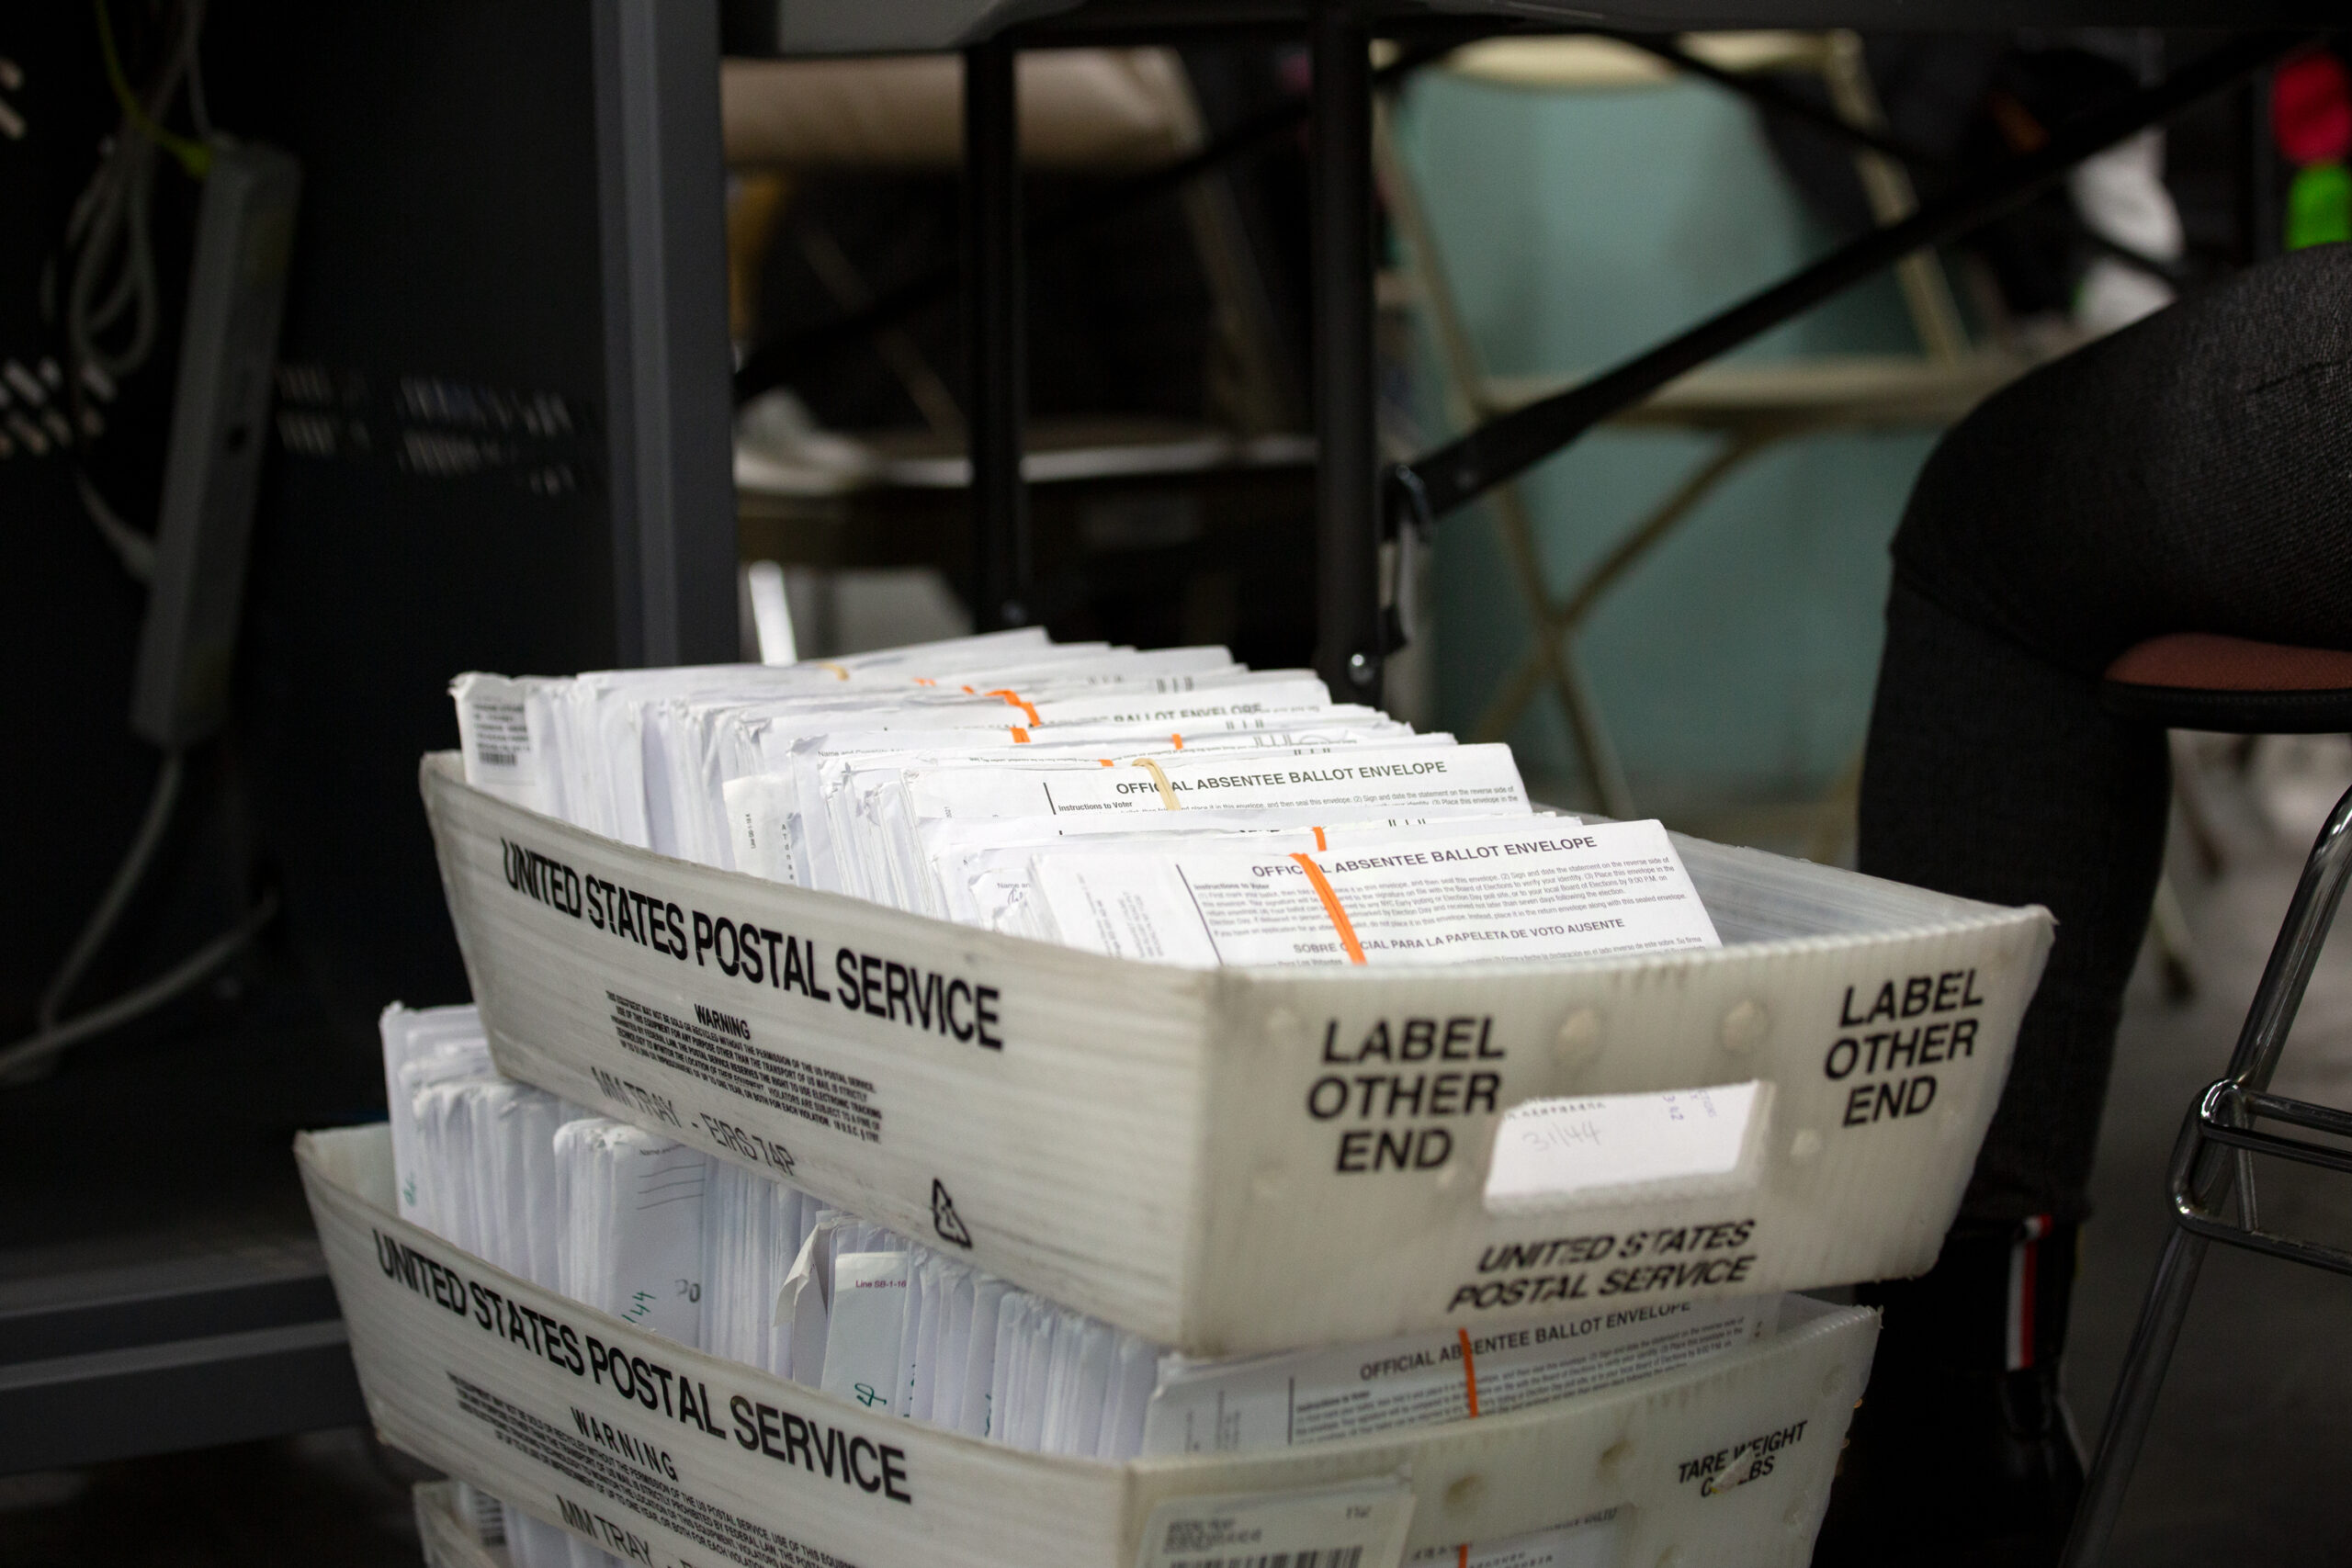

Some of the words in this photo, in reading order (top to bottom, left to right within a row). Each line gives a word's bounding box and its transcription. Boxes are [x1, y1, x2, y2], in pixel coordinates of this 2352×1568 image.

[1196, 773, 1285, 790] ABSENTEE
[1289, 768, 1353, 783] BALLOT
[1358, 761, 1448, 778] ENVELOPE
[1058, 804, 1102, 812] Instructions
[1335, 851, 1430, 873] ABSENTEE
[1433, 846, 1499, 863] BALLOT
[1504, 836, 1598, 855] ENVELOPE
[1540, 895, 1555, 905] days
[1555, 891, 1586, 903] following
[1599, 887, 1625, 896] election.
[1558, 902, 1587, 913] envelope
[1588, 900, 1607, 910] along
[1608, 898, 1620, 907] with
[1622, 897, 1634, 905] this
[1635, 895, 1656, 903] sealed
[1657, 892, 1687, 903] envelope.
[501, 837, 582, 919] UNITED
[585, 874, 687, 961] STATES
[693, 910, 831, 1002] POSTAL
[836, 948, 1003, 1052] SERVICE
[1294, 942, 1338, 953] SOBRE
[1392, 937, 1427, 950] PARA
[1427, 935, 1444, 947] LA
[1445, 931, 1509, 944] PAPELETA
[1511, 931, 1529, 939] DE
[1530, 926, 1566, 937] VOTO
[1567, 919, 1625, 933] AUSENTE
[694, 1004, 751, 1040] WARNING
[1839, 967, 1984, 1028] LABEL
[1321, 1016, 1507, 1065] LABEL
[1825, 1018, 1979, 1081] OTHER
[1307, 1071, 1501, 1122] OTHER
[1843, 1075, 1938, 1128] END
[623, 1080, 682, 1128] TRAY
[751, 1134, 795, 1176] 74P
[1335, 1127, 1453, 1175] END
[1476, 1235, 1615, 1275] UNITED
[1618, 1219, 1756, 1259] STATES
[855, 1280, 873, 1288] Line
[1446, 1272, 1589, 1323] POSTAL
[1598, 1255, 1757, 1298] SERVICE
[372, 1228, 467, 1316] UNITED
[469, 1280, 584, 1377] STATES
[585, 1334, 727, 1440] POSTAL
[729, 1394, 912, 1506] SERVICE
[1360, 1351, 1436, 1381] OFFICIAL
[1535, 1317, 1602, 1345] BALLOT
[570, 1405, 679, 1483] WARNING
[1679, 1449, 1728, 1483] TARE
[556, 1494, 598, 1540] MM
[594, 1514, 653, 1567] TRAY
[671, 1485, 680, 1500] OF
[681, 1490, 695, 1507] THE
[697, 1498, 707, 1512] US
[707, 1503, 733, 1525] POSTAL
[736, 1516, 770, 1541] SERVICE.
[772, 1531, 786, 1549] USE
[789, 1539, 799, 1553] OF
[800, 1543, 819, 1561] THIS
